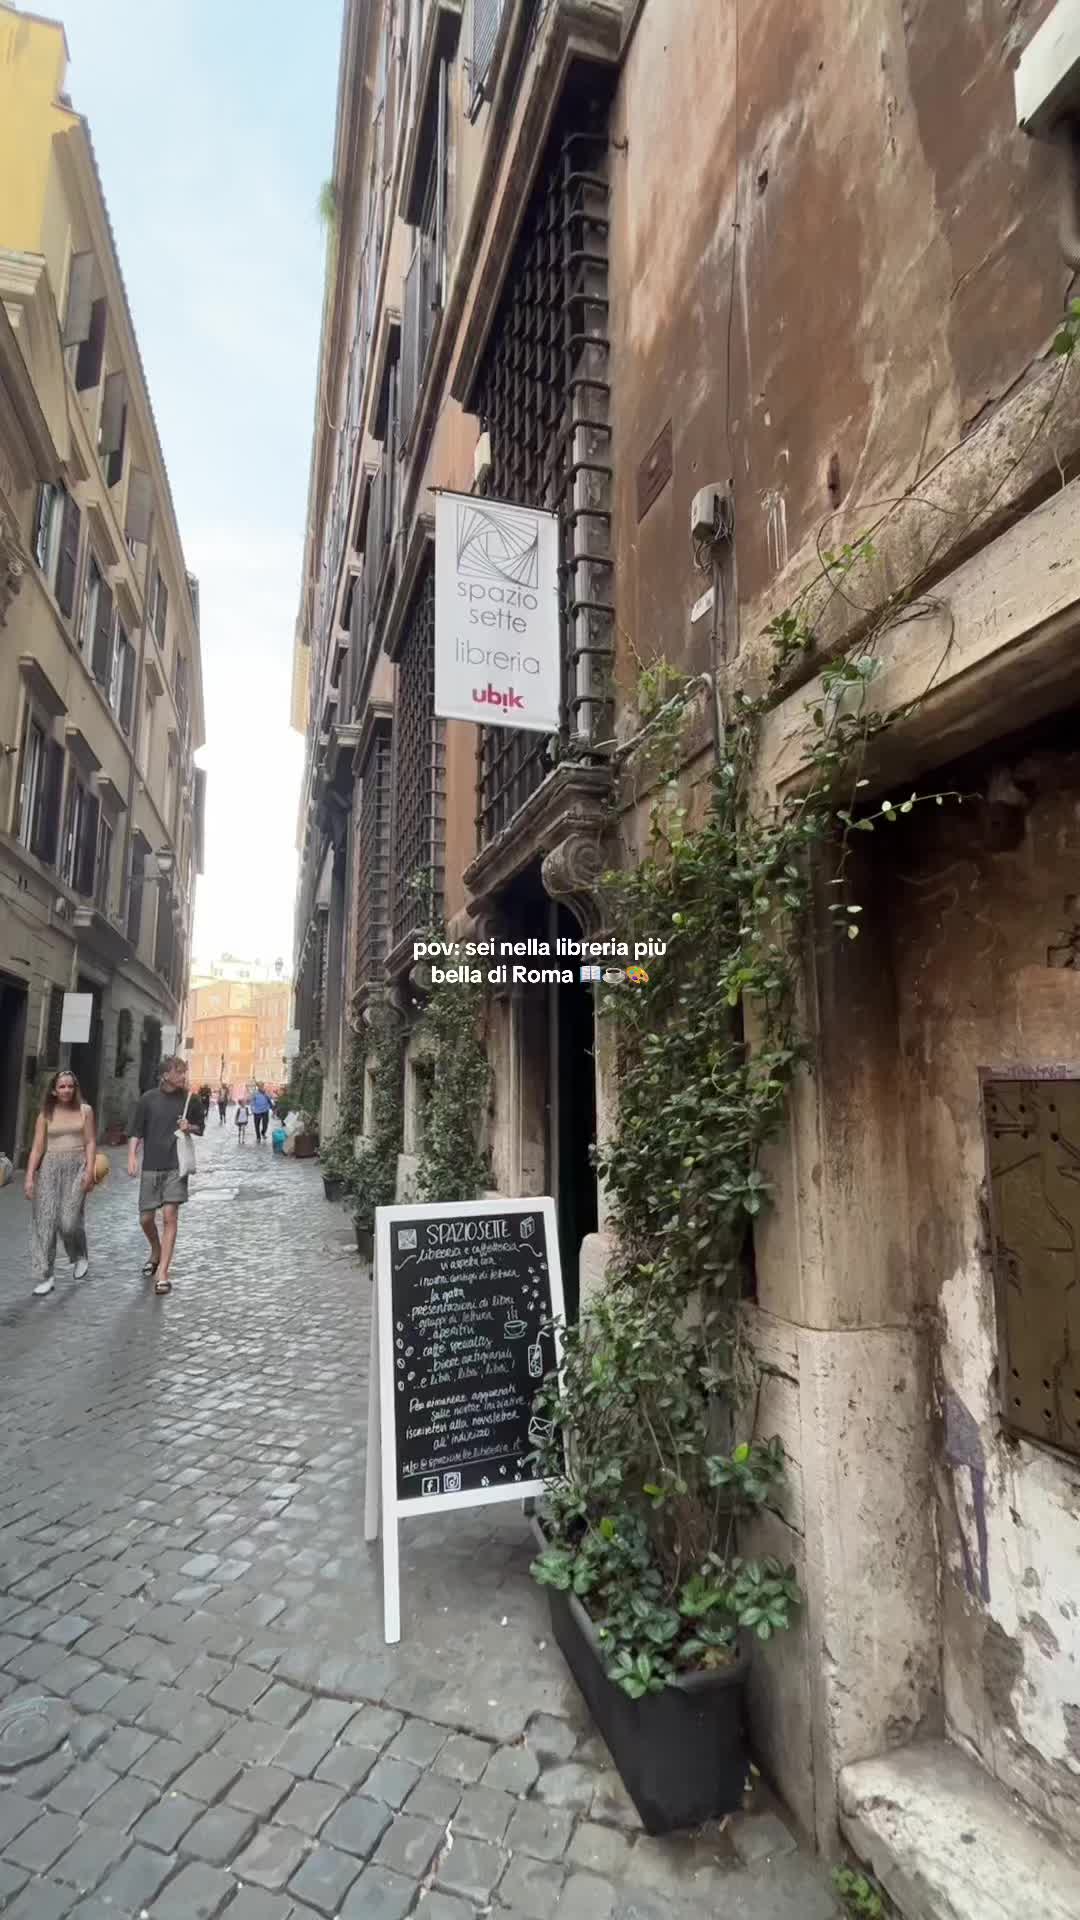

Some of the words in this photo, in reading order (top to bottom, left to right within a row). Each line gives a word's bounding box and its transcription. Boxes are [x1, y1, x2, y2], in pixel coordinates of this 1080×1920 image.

[457, 581, 538, 610] spazio
[469, 608, 527, 634] sette
[455, 637, 540, 675] libreria
[472, 683, 525, 713] ubik
[426, 1219, 511, 1245] SPAZIOSETTE
[411, 1300, 477, 1321] presentazioni
[478, 1298, 489, 1309] di
[492, 1295, 515, 1306] libri
[462, 1310, 495, 1323] lettura
[449, 1418, 470, 1432] alla
